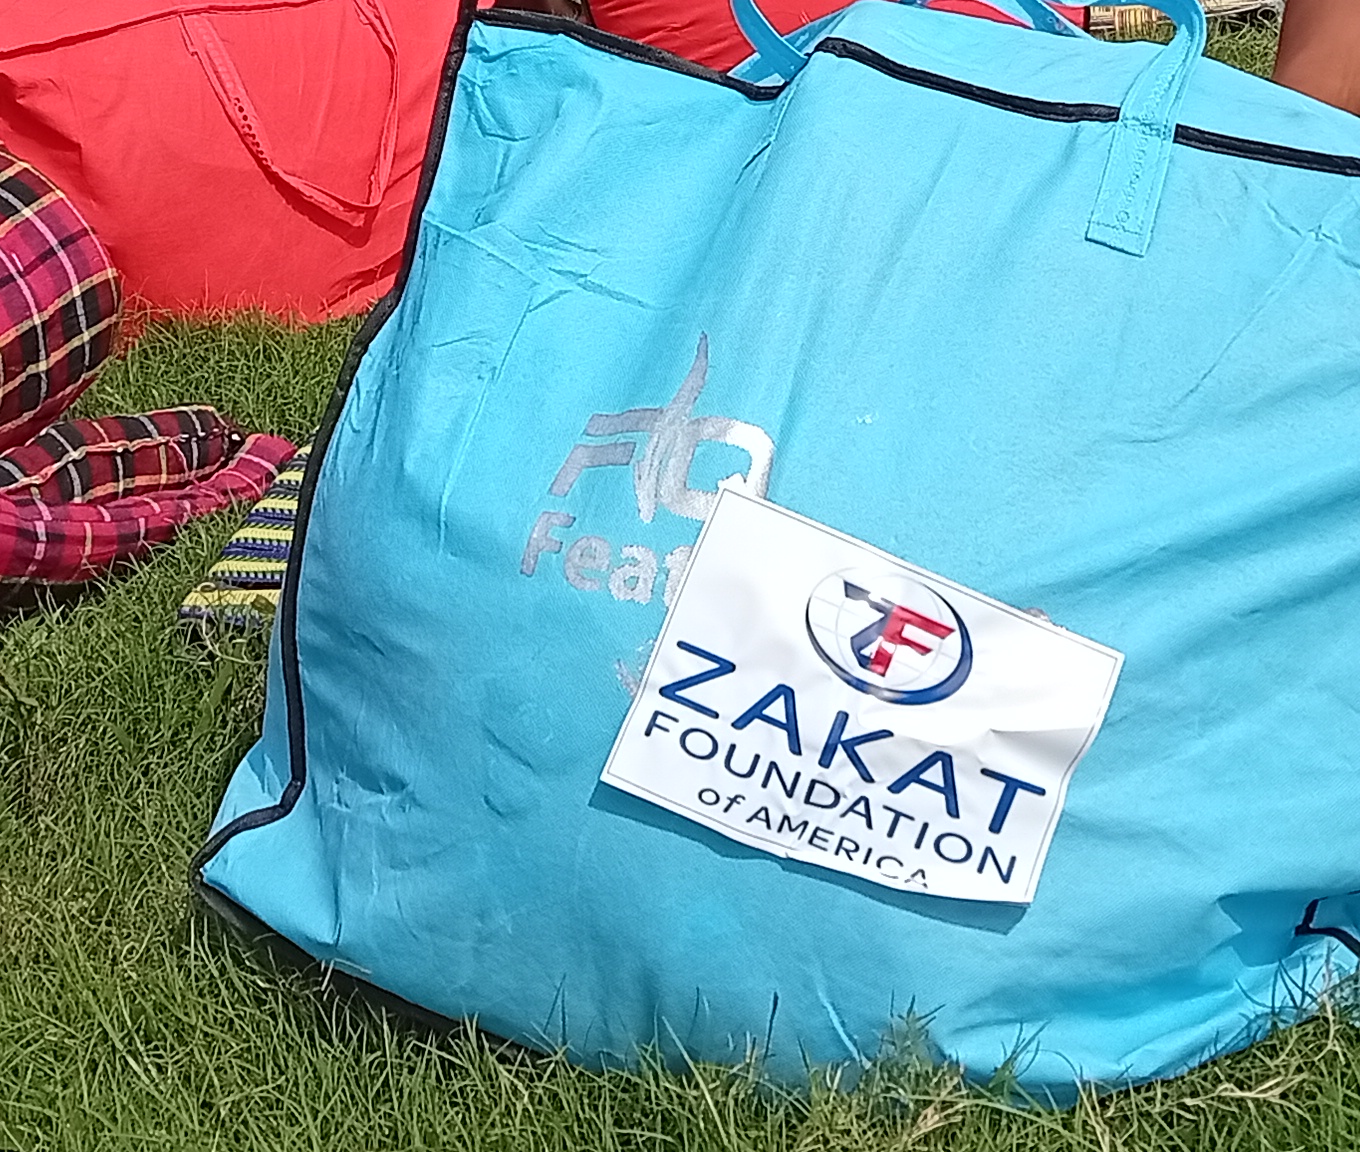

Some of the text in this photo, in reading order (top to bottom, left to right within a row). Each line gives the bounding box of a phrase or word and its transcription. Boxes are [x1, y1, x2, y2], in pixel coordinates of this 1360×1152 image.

[644, 709, 1017, 885] FOUNDATION
[659, 639, 1047, 835] ZAKAT
[697, 787, 929, 889] of AMERICA
